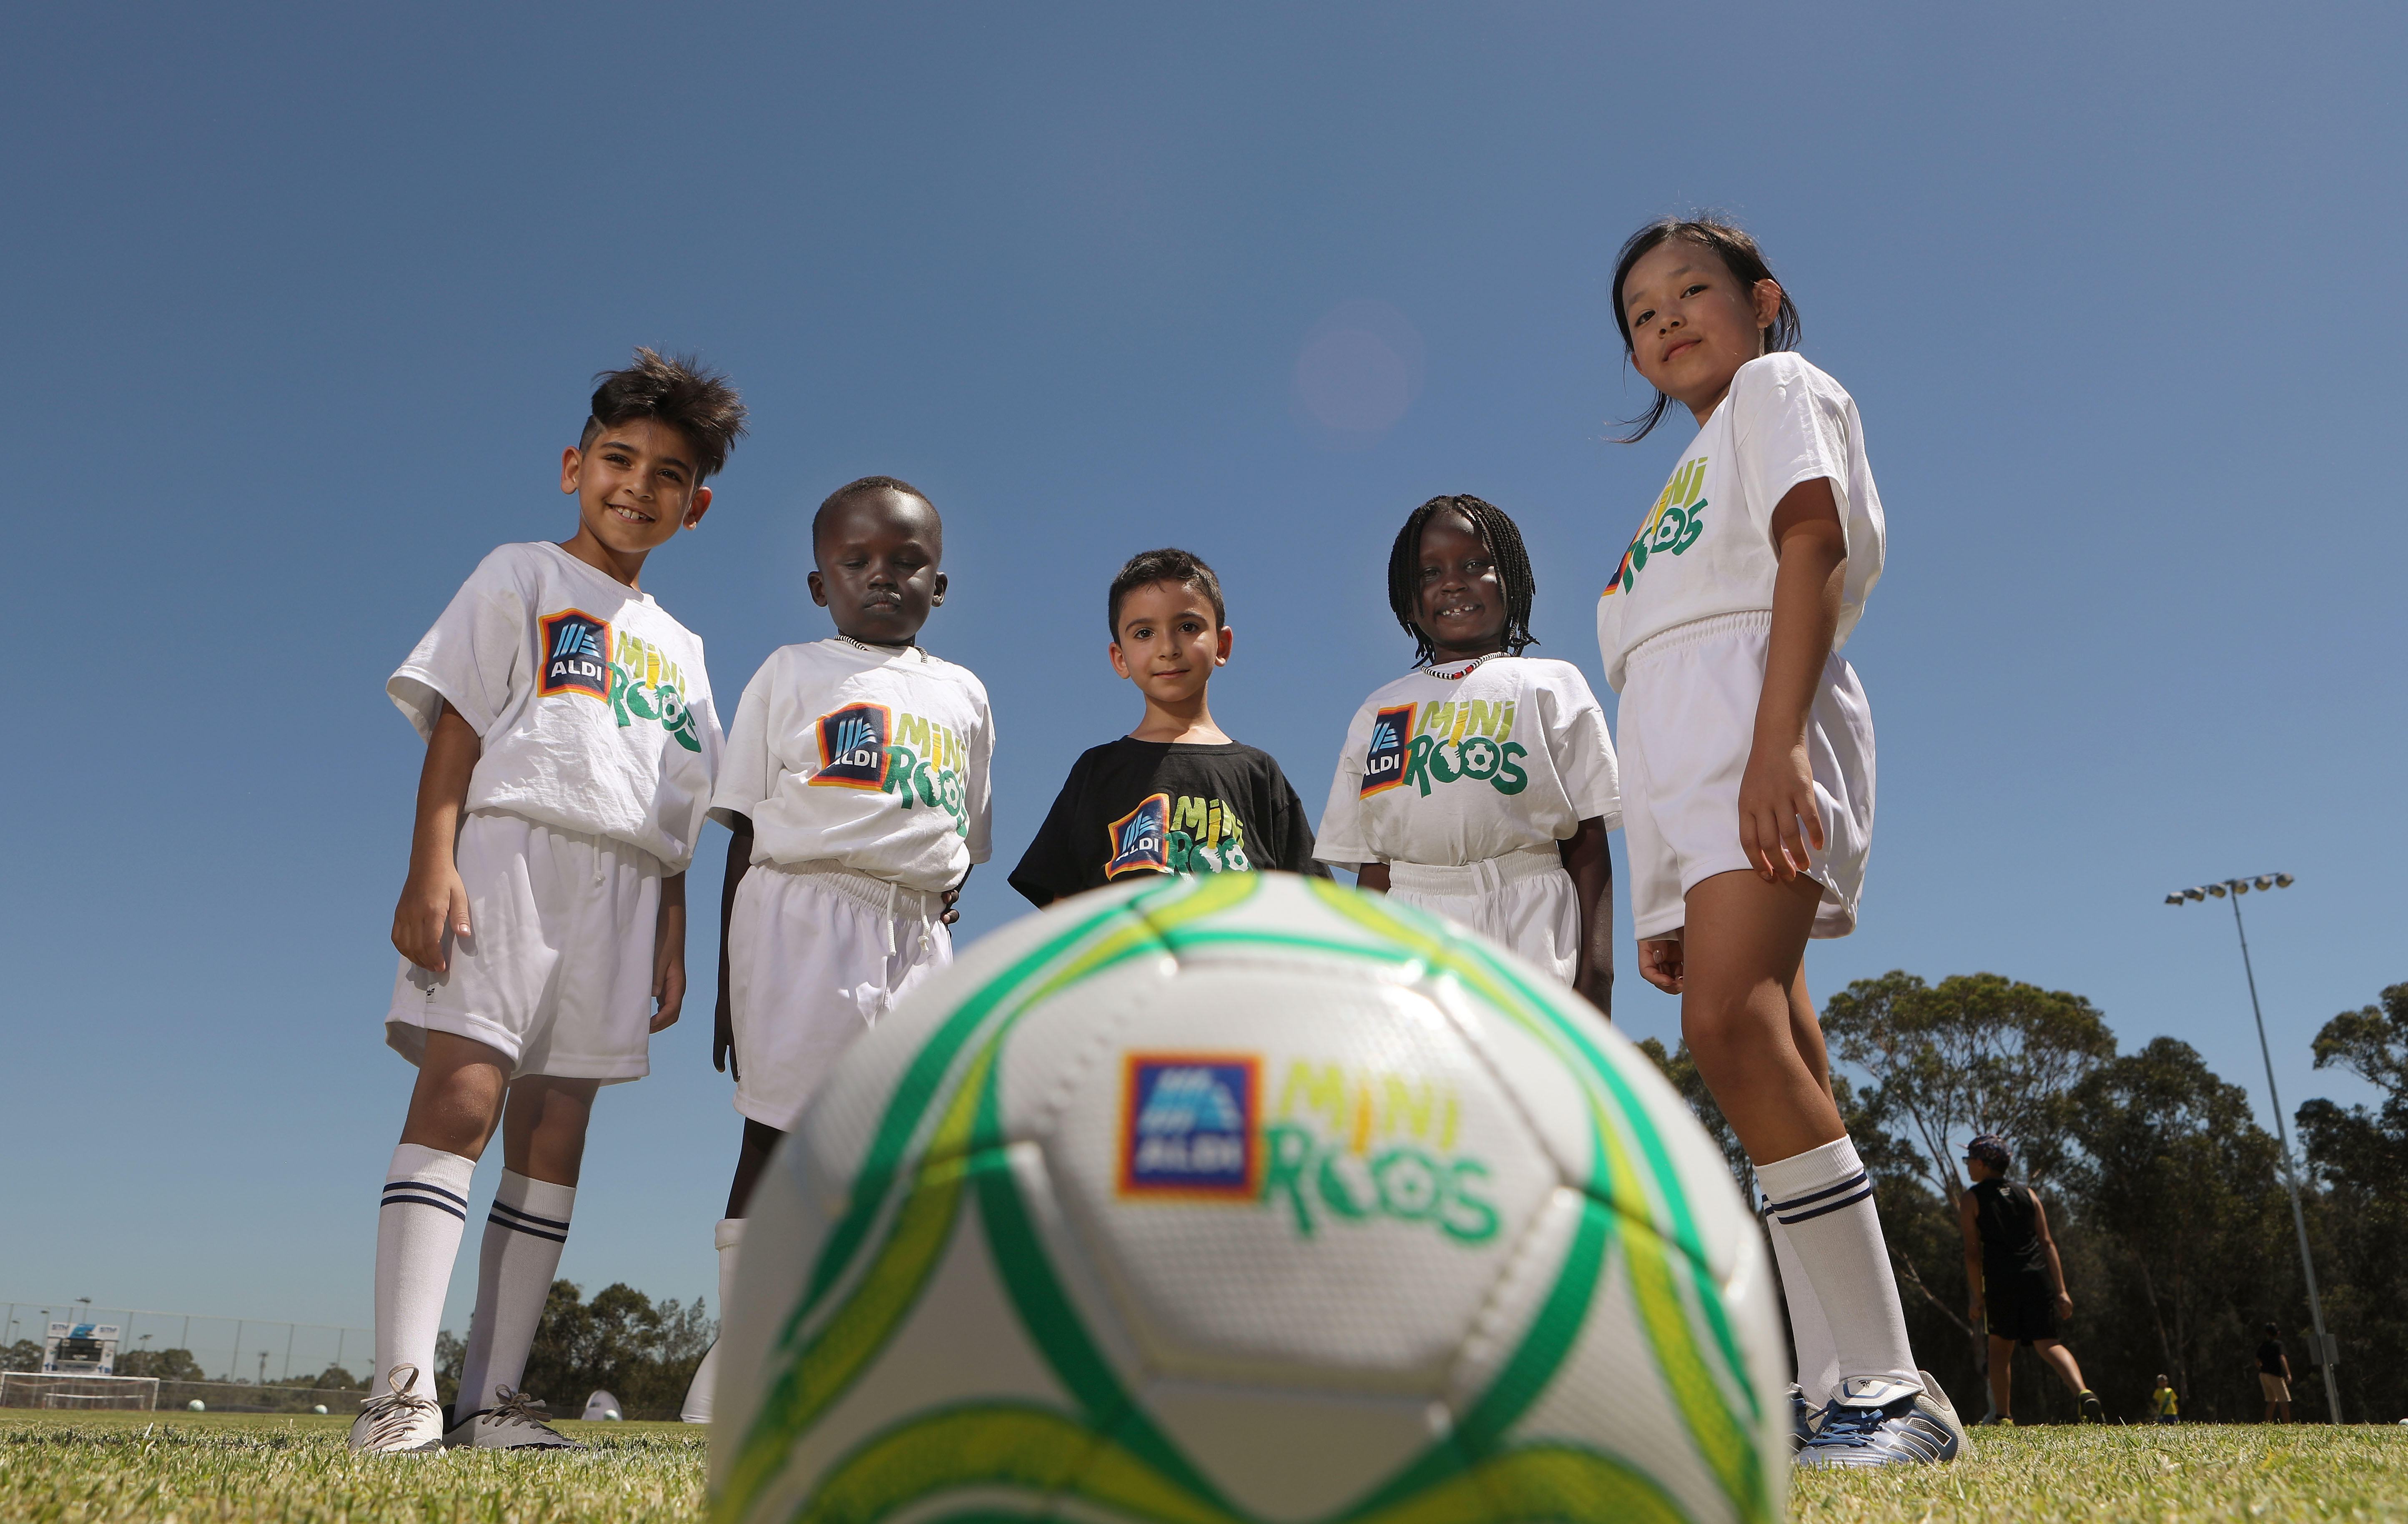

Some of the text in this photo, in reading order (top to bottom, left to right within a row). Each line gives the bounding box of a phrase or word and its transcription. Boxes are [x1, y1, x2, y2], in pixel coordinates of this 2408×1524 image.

[551, 660, 602, 682] ALDI
[606, 662, 702, 753] ROOS
[1402, 735, 1528, 798] ROOS
[1136, 1134, 1244, 1172] ALDI
[1262, 1121, 1503, 1245] ROOS
